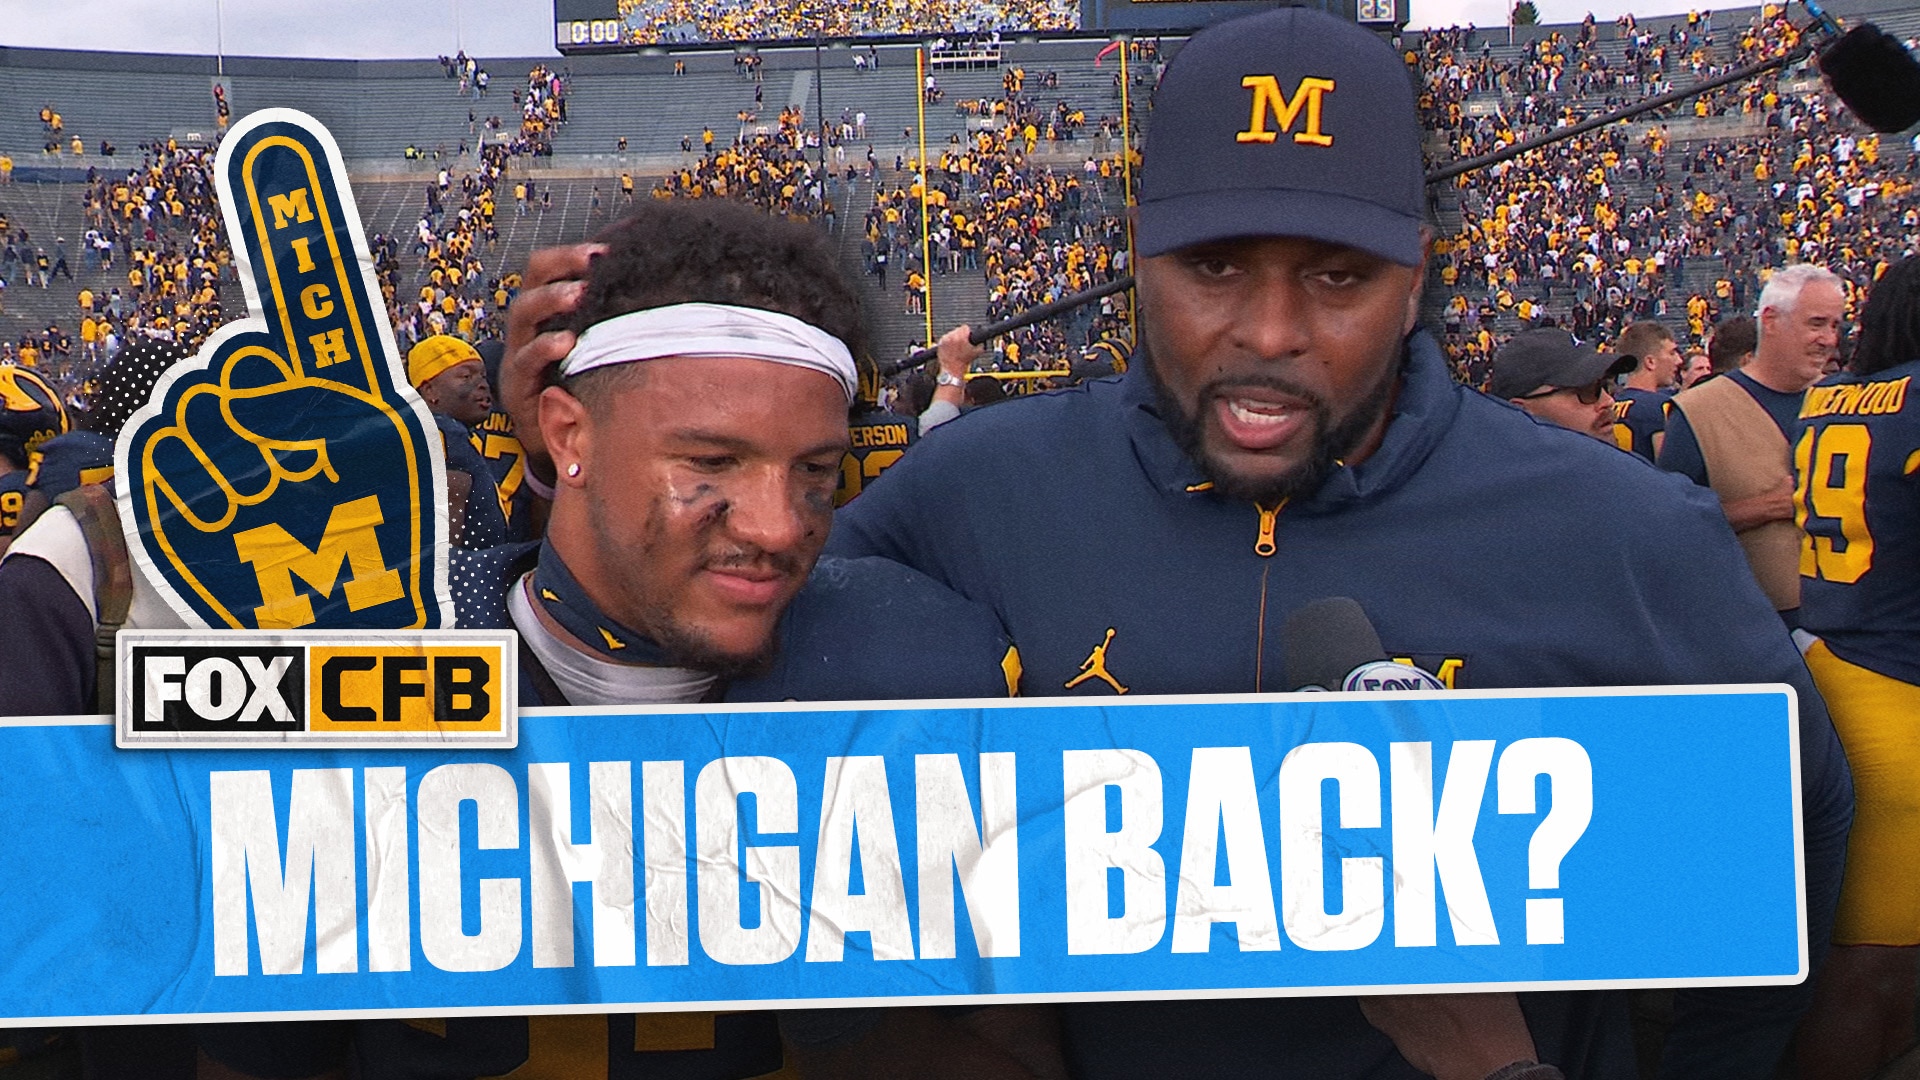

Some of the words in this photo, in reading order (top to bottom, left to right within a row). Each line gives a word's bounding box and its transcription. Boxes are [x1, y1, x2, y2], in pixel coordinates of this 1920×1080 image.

[571, 20, 618, 43] 0:00
[1236, 75, 1335, 147] M
[1793, 424, 1875, 583] 19
